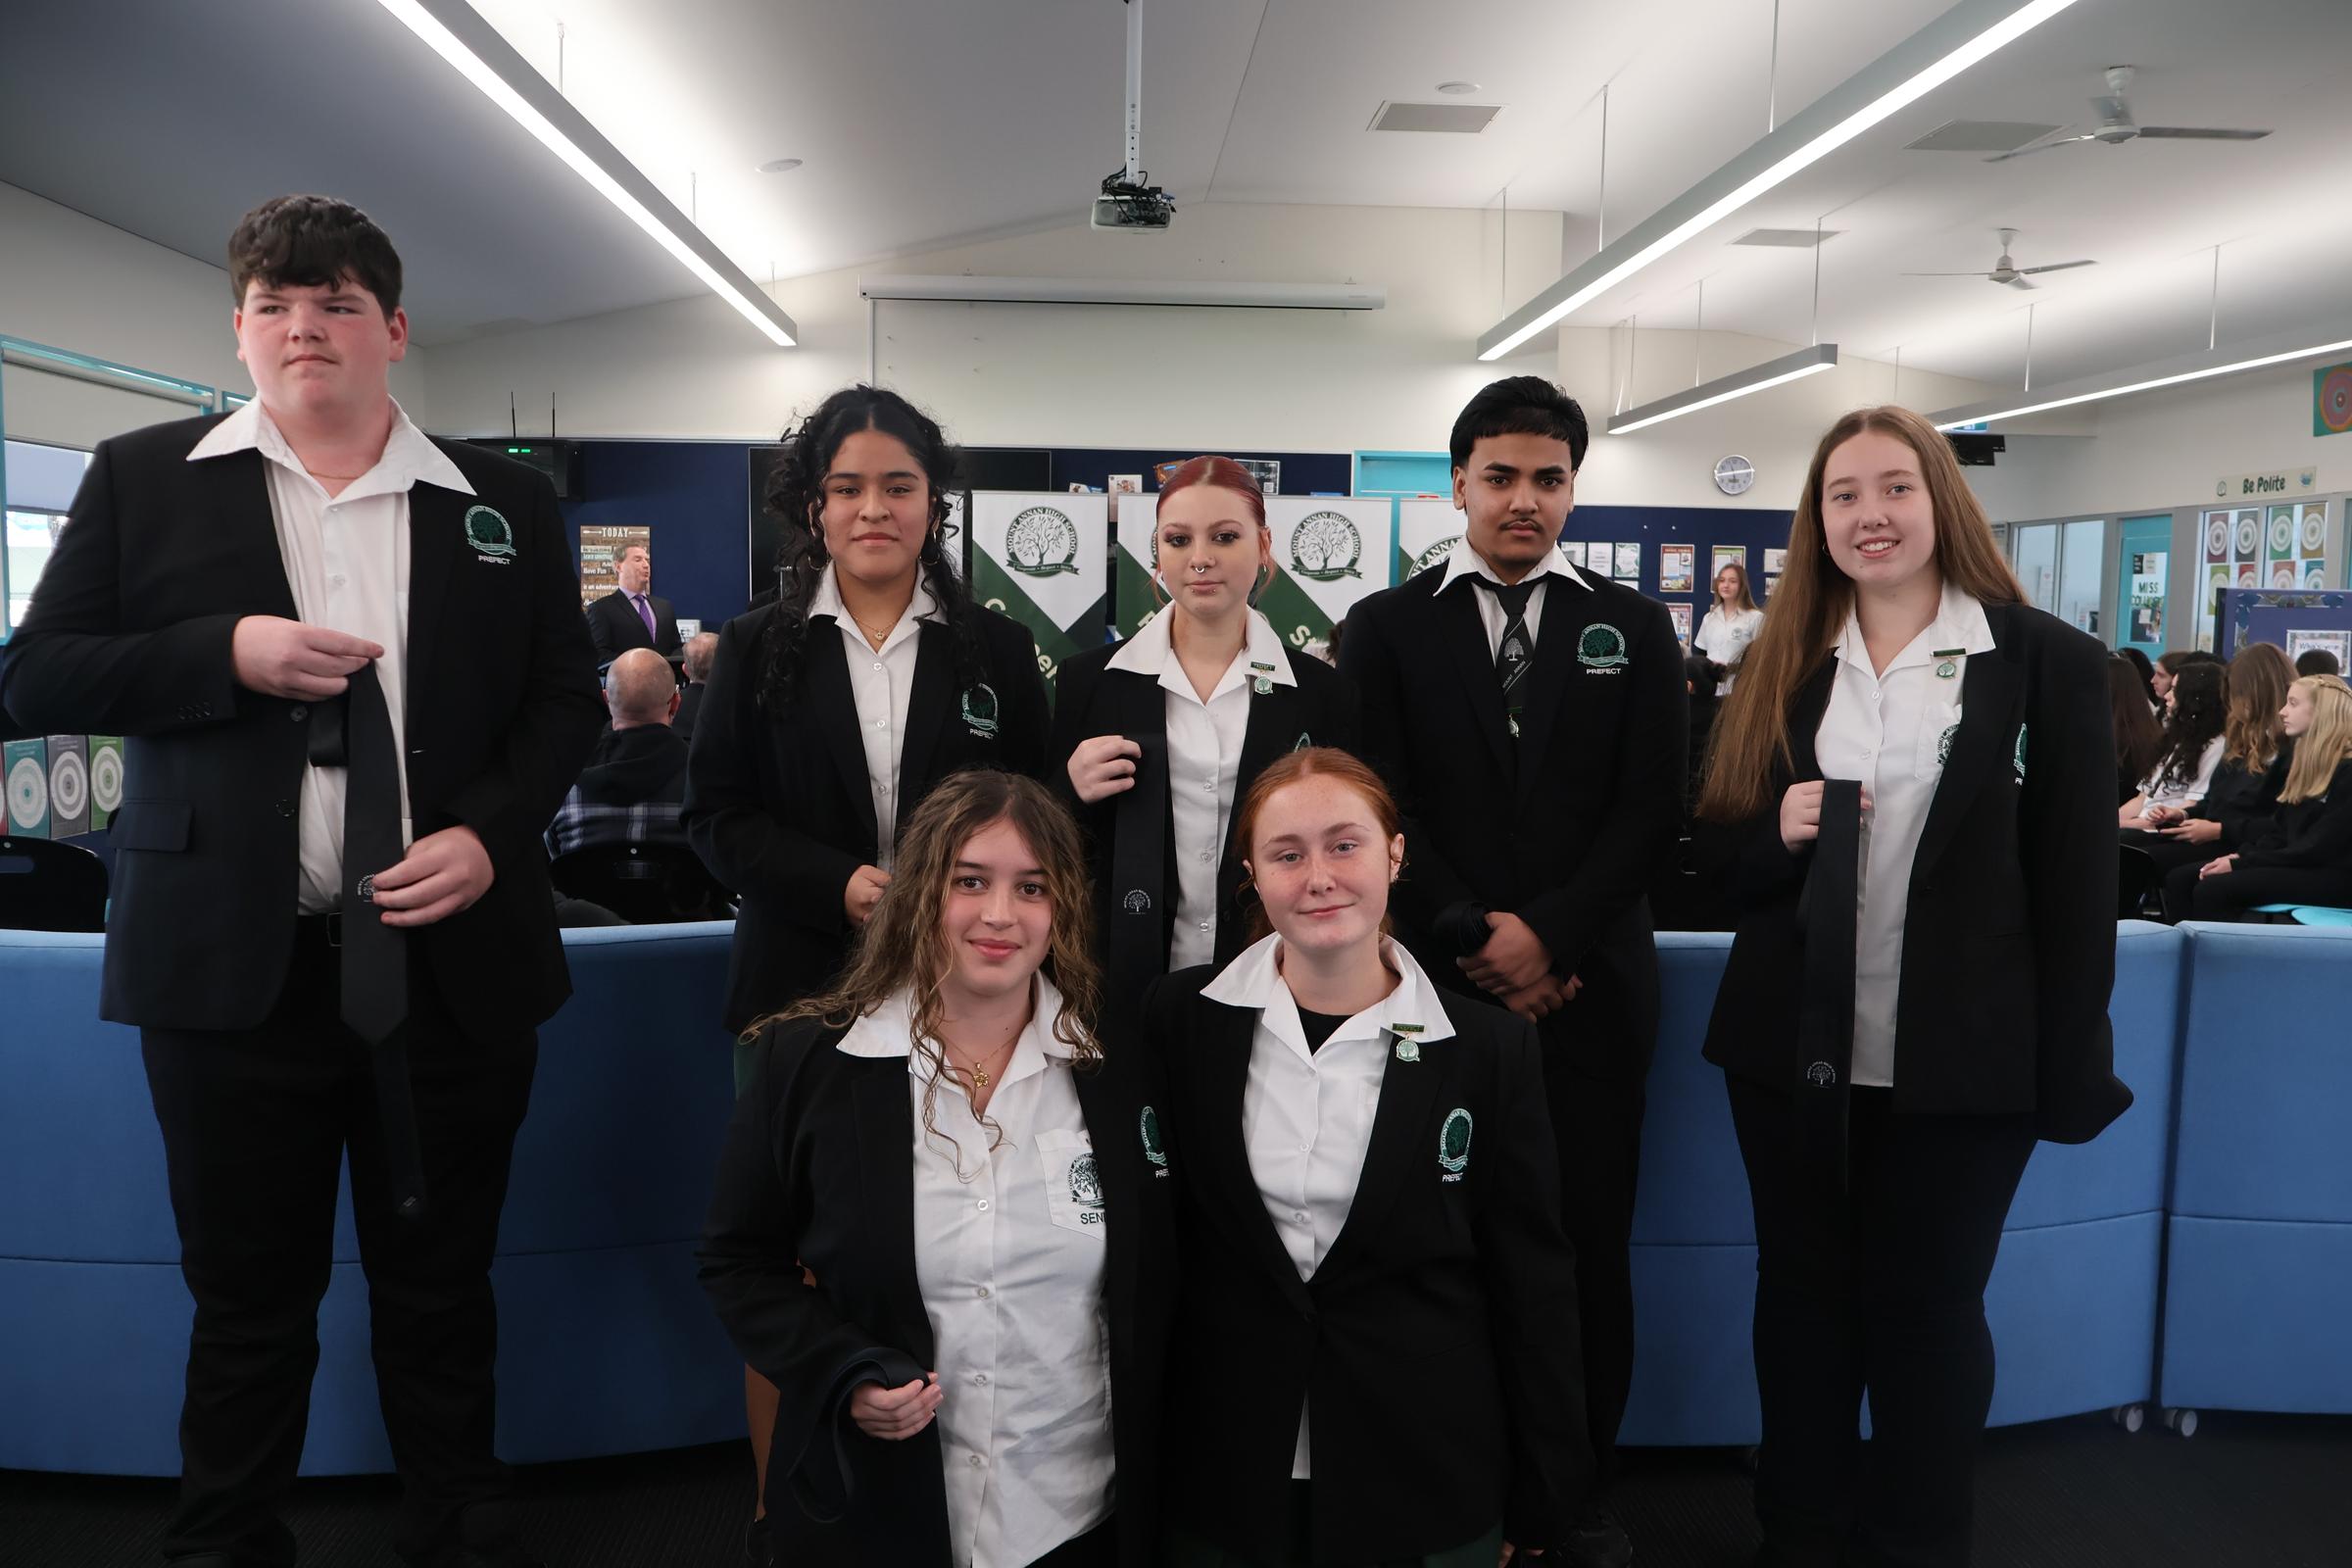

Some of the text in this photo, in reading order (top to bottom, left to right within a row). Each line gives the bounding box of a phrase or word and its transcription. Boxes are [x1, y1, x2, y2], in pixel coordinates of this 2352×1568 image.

[2242, 475, 2285, 494] Be Polite
[1018, 508, 1044, 522] ANNAN
[1045, 508, 1066, 523] HIGH
[1302, 513, 1328, 527] ANNAN
[1329, 513, 1350, 527] HIGH
[602, 527, 628, 538] TODAY
[1425, 539, 1458, 563] ANNA
[477, 555, 511, 565] PREFECT
[2138, 582, 2159, 593] MISS
